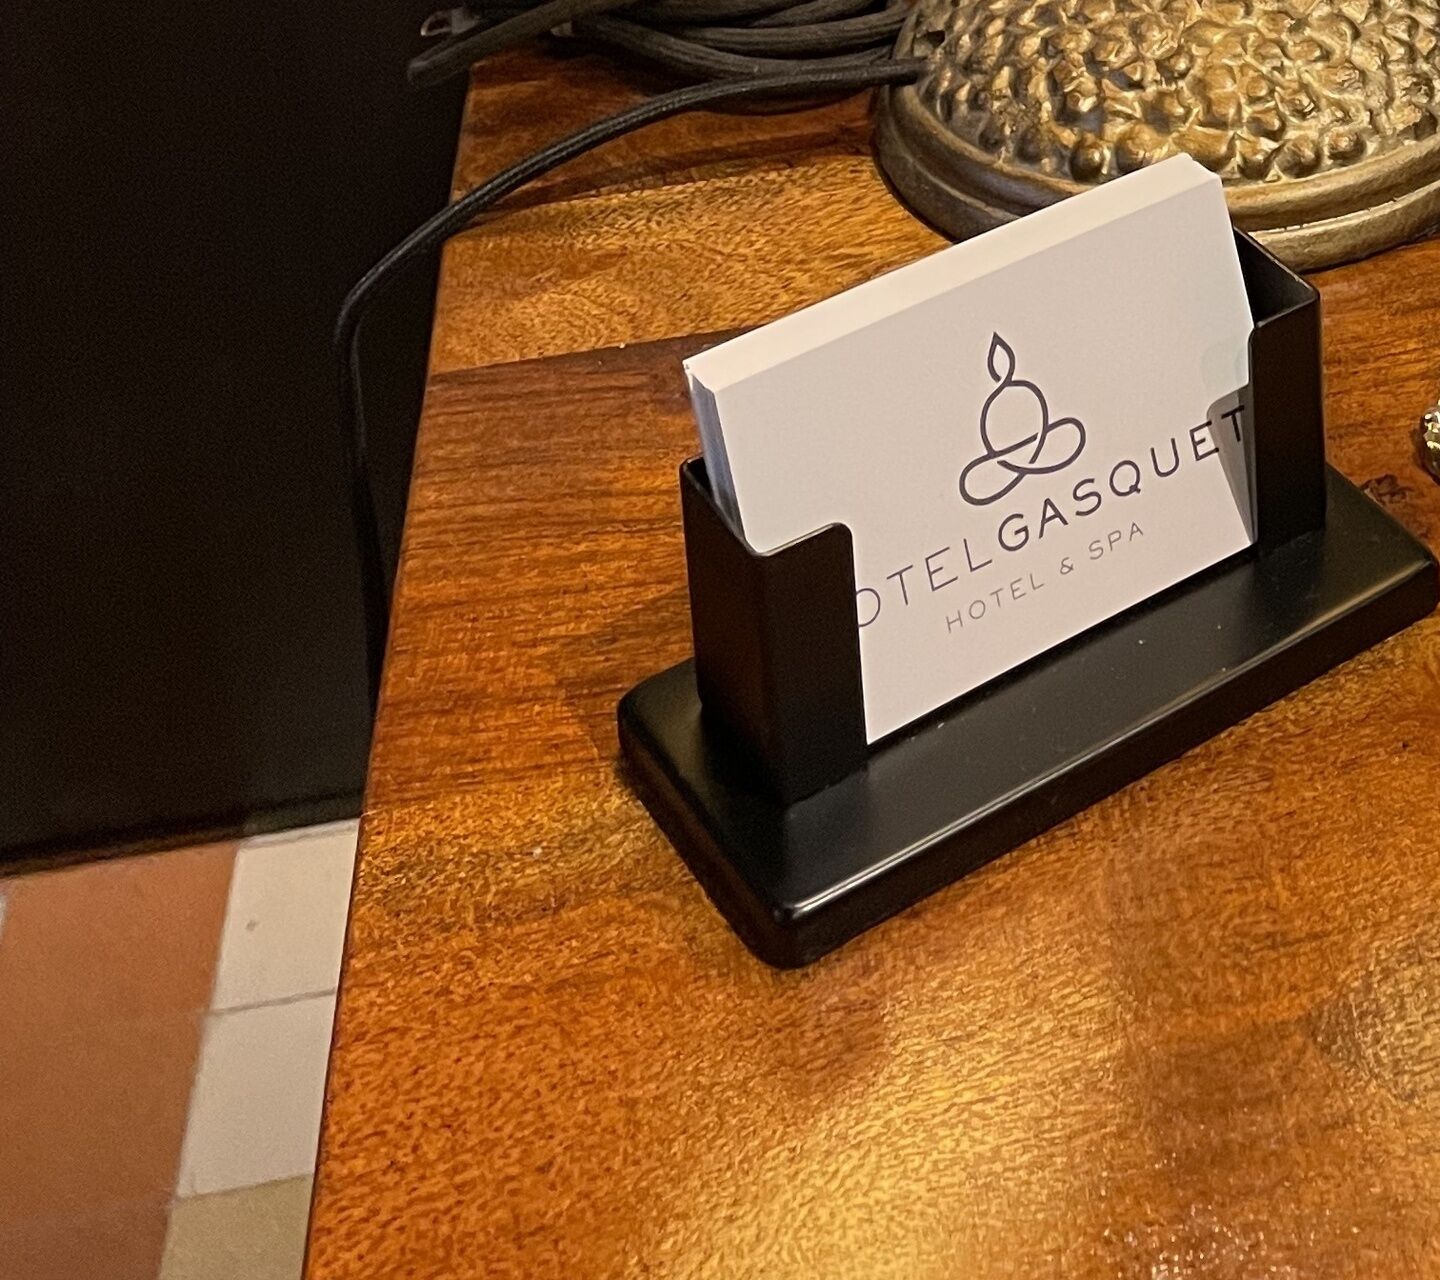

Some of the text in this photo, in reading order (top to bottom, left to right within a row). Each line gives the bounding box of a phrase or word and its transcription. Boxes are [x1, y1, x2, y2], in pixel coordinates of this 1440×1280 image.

[855, 404, 1245, 628] OTELGASQUET
[945, 521, 1145, 634] HOTEL & SPA
